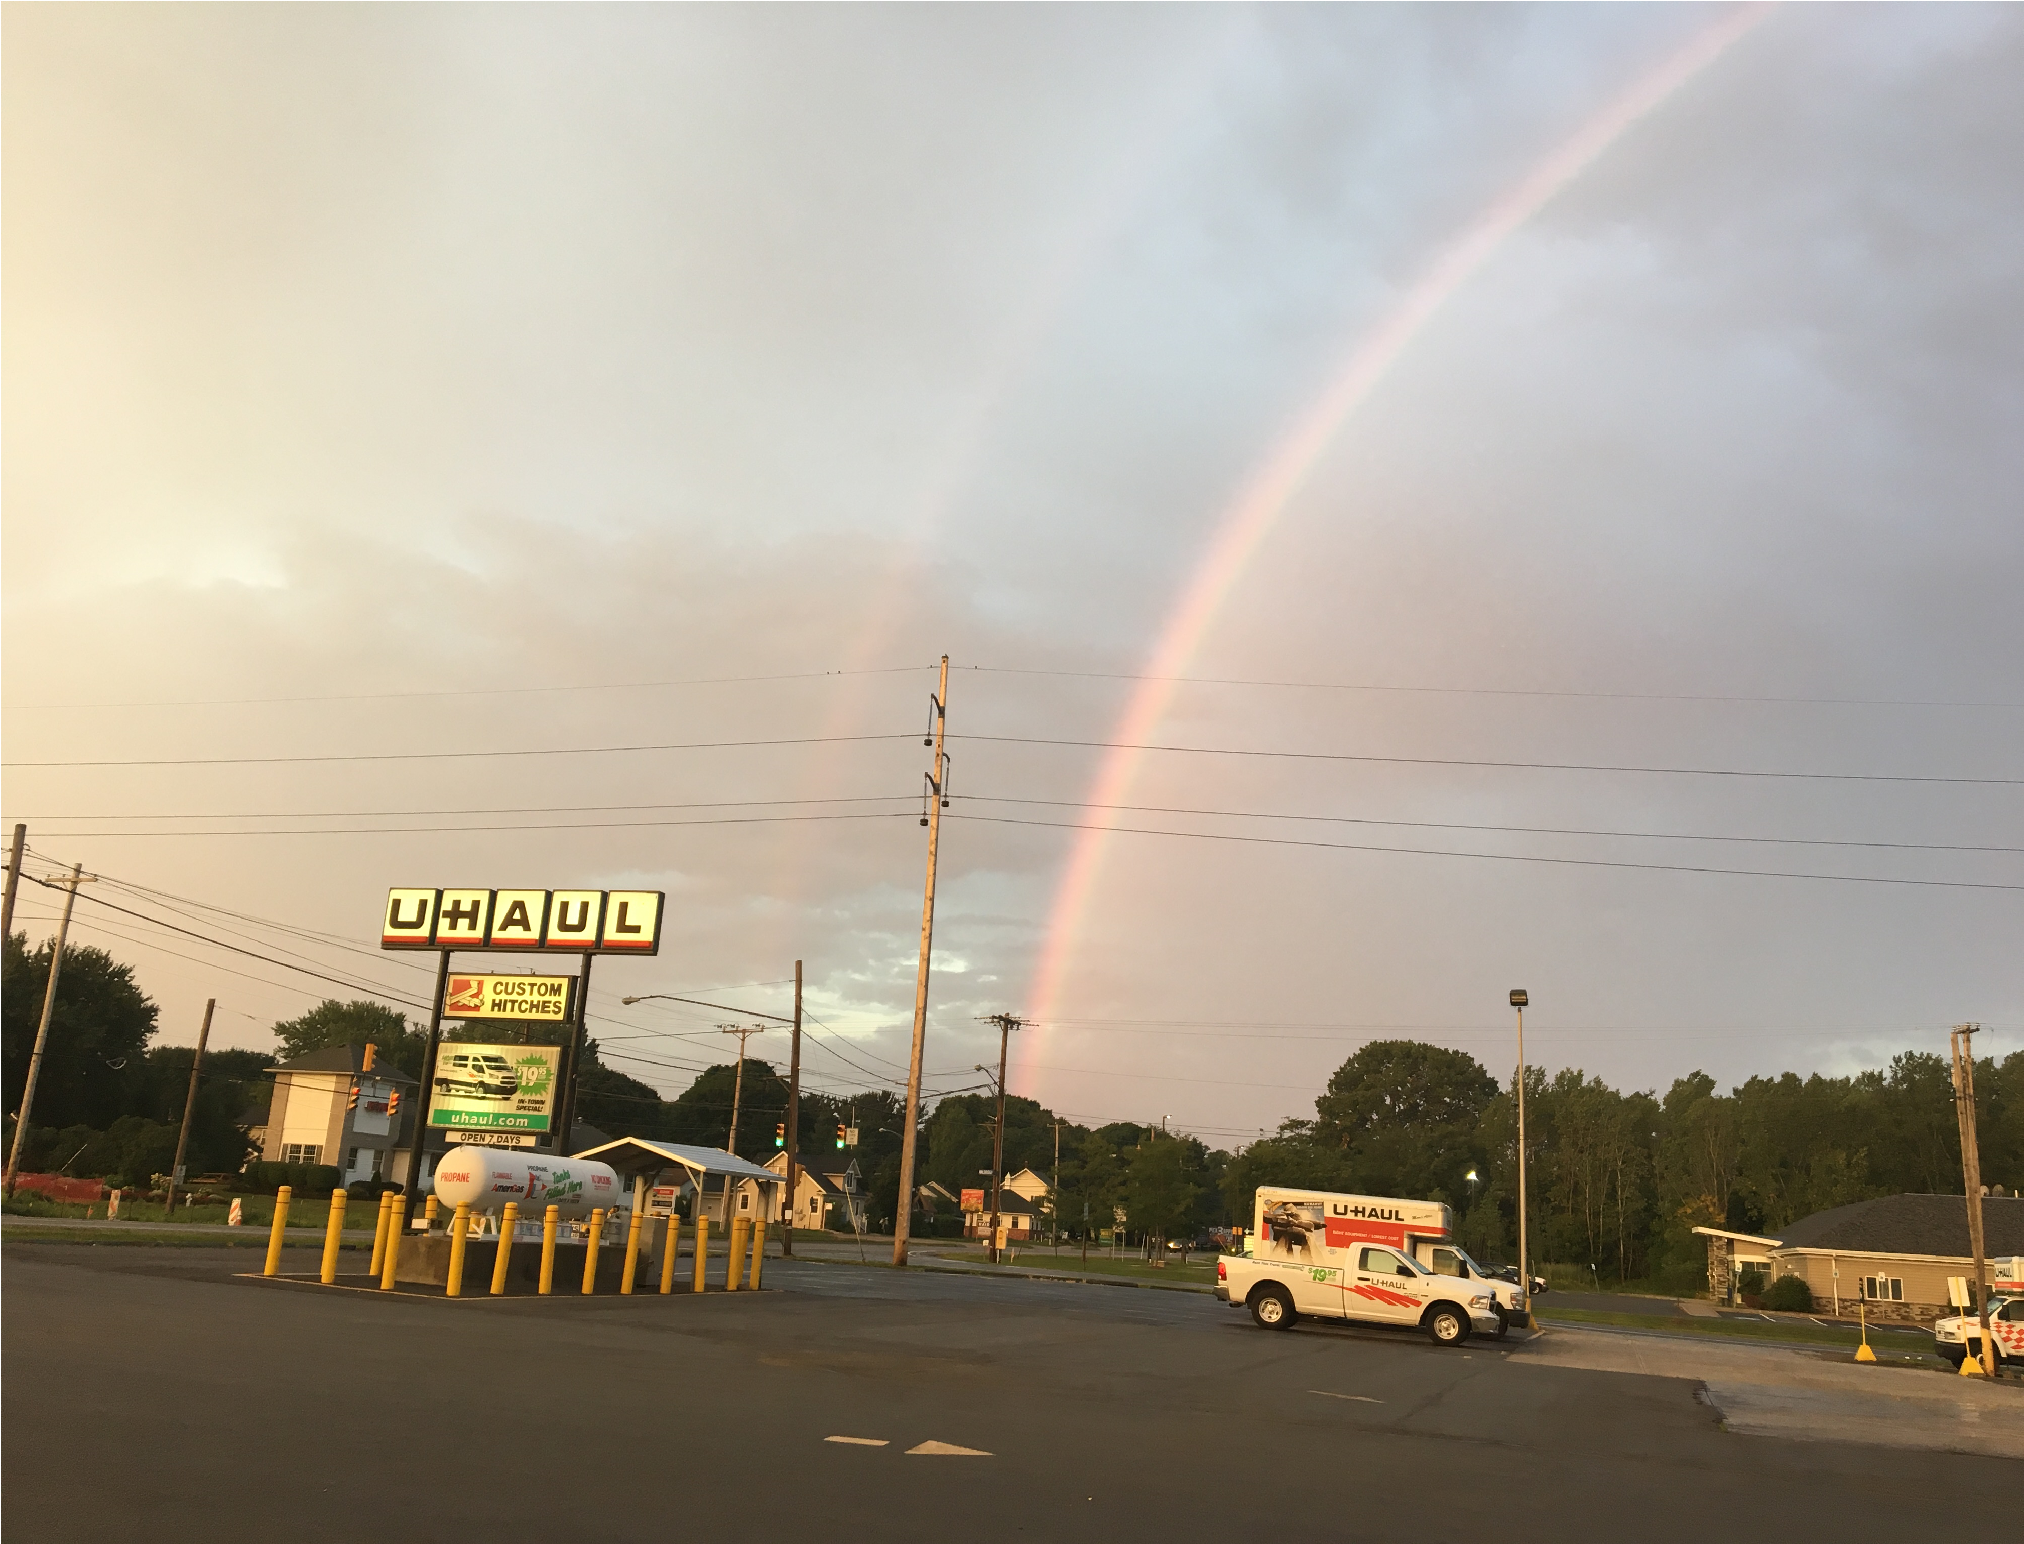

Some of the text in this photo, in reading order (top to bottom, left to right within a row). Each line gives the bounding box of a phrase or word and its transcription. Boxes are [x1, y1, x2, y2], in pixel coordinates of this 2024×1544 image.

[493, 981, 562, 997] CUSTOM
[490, 999, 562, 1015] HITCHES
[451, 1113, 528, 1126] uhaul.com
[460, 1133, 521, 1144] OPEN 7 DAYS
[440, 1172, 470, 1182] PROPANE
[491, 1183, 524, 1193] AmeriGas
